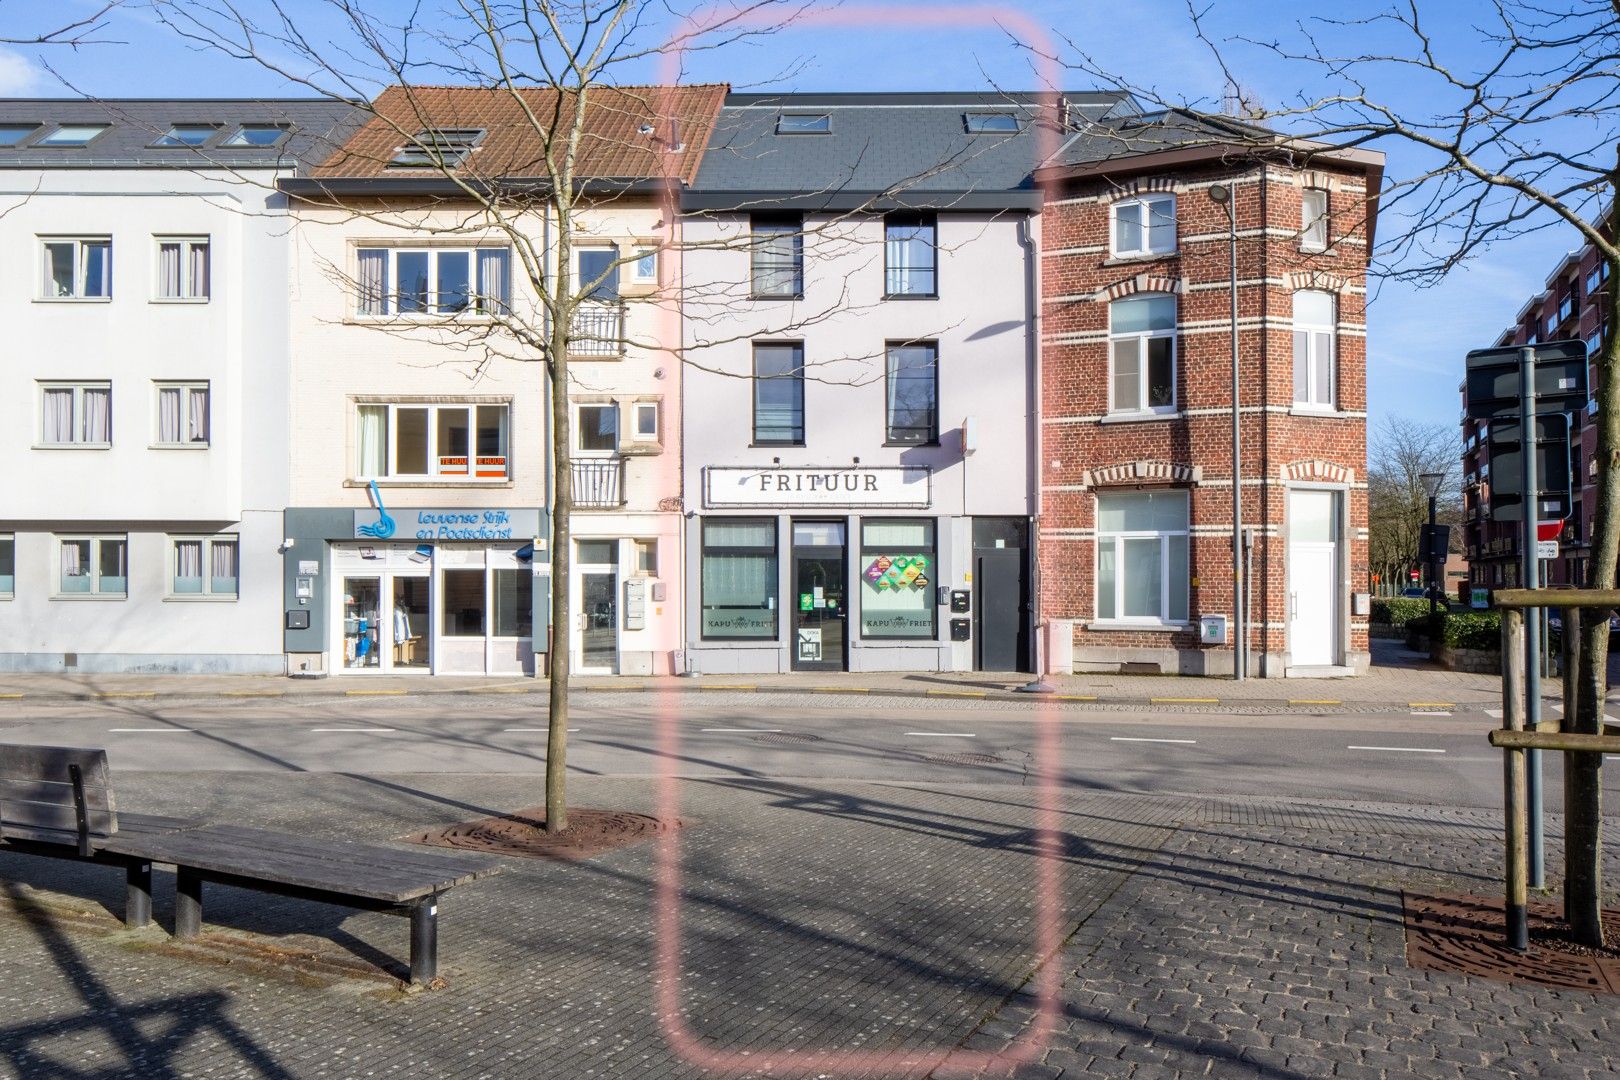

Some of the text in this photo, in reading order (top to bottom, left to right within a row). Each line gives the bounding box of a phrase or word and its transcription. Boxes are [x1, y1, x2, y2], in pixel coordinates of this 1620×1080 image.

[760, 474, 879, 492] FRITUUR
[418, 511, 479, 524] Leuvense
[416, 526, 512, 540] en Poetsdienst
[708, 620, 731, 628] KAPU
